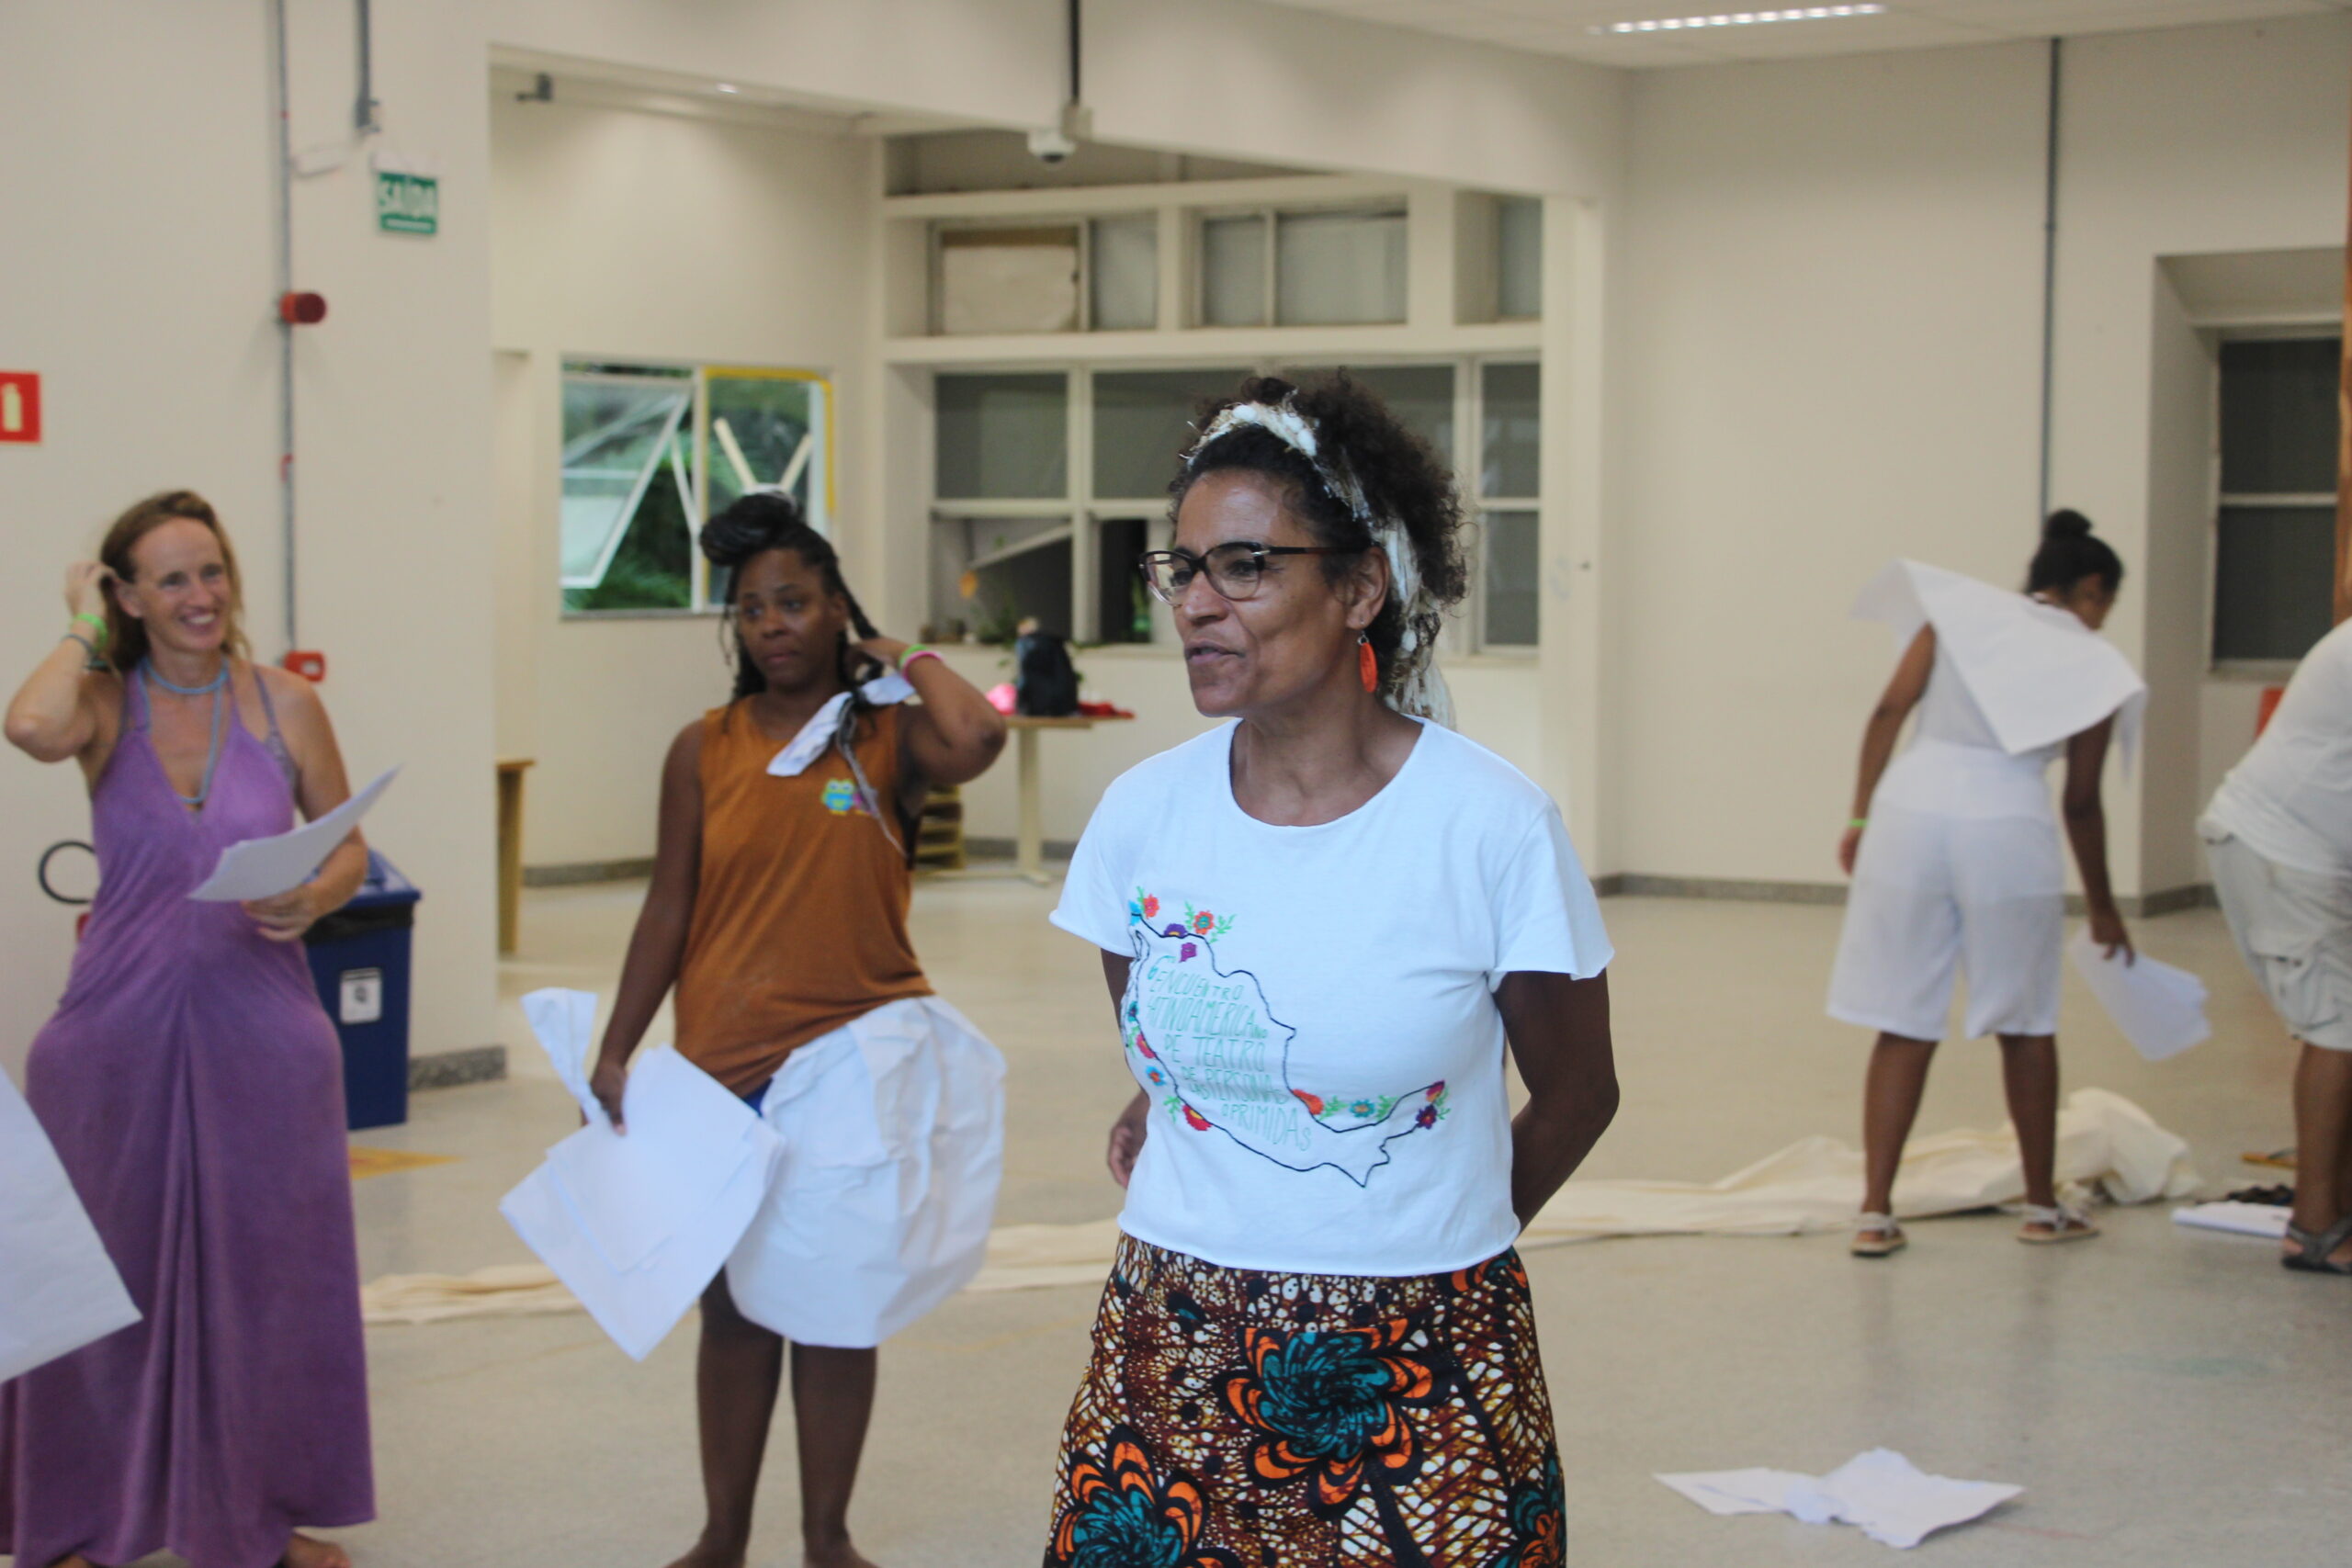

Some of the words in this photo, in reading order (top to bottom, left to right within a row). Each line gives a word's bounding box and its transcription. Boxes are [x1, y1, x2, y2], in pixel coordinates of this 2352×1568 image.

[1149, 970, 1244, 1000] ENCUENTRO
[1164, 1033, 1182, 1064] DE
[1192, 1036, 1266, 1072] TEATRO
[1221, 1104, 1312, 1151] OPRIMIDAS
